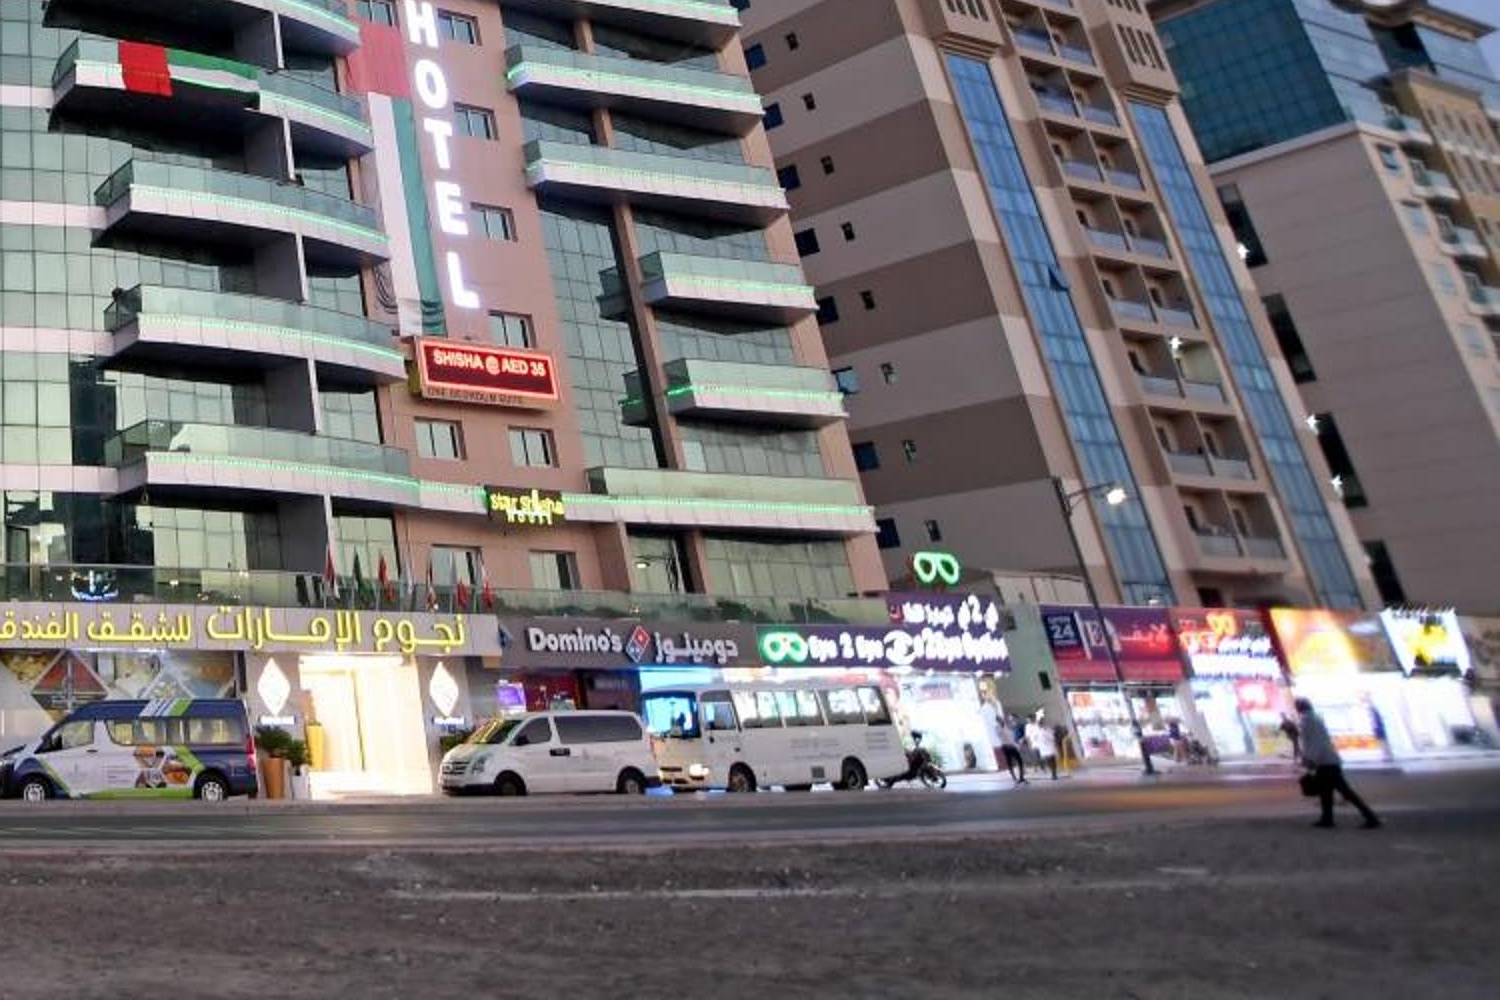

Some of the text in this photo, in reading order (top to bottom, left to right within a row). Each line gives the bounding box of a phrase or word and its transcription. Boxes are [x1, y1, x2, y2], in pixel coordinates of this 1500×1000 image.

[433, 350, 484, 369] SHISHA
[501, 358, 529, 374] AED
[87, 611, 192, 642] للشقق
[207, 606, 361, 652] الإمارات
[373, 614, 465, 653] نجوم
[528, 627, 622, 653] Domino's
[1050, 623, 1075, 639] 24
[655, 632, 739, 664] دومينوز
